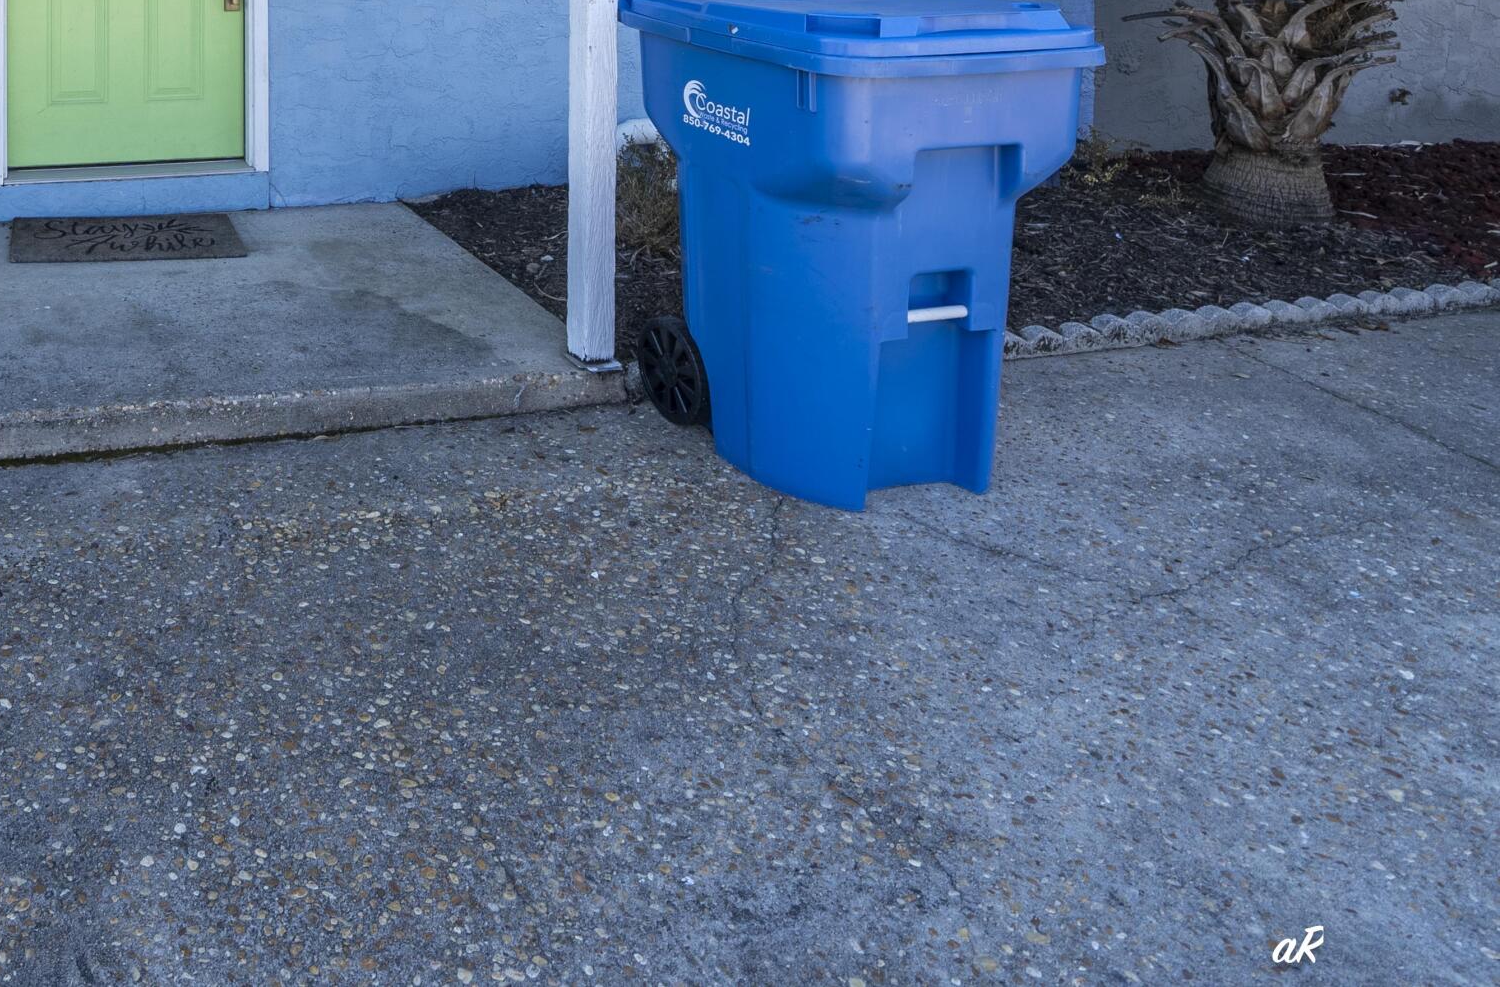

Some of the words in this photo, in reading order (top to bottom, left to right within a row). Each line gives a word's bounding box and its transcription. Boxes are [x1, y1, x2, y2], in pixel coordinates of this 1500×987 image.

[696, 92, 751, 126] Coastal
[683, 114, 751, 147] 850-769-4304
[720, 118, 748, 135] Recycling
